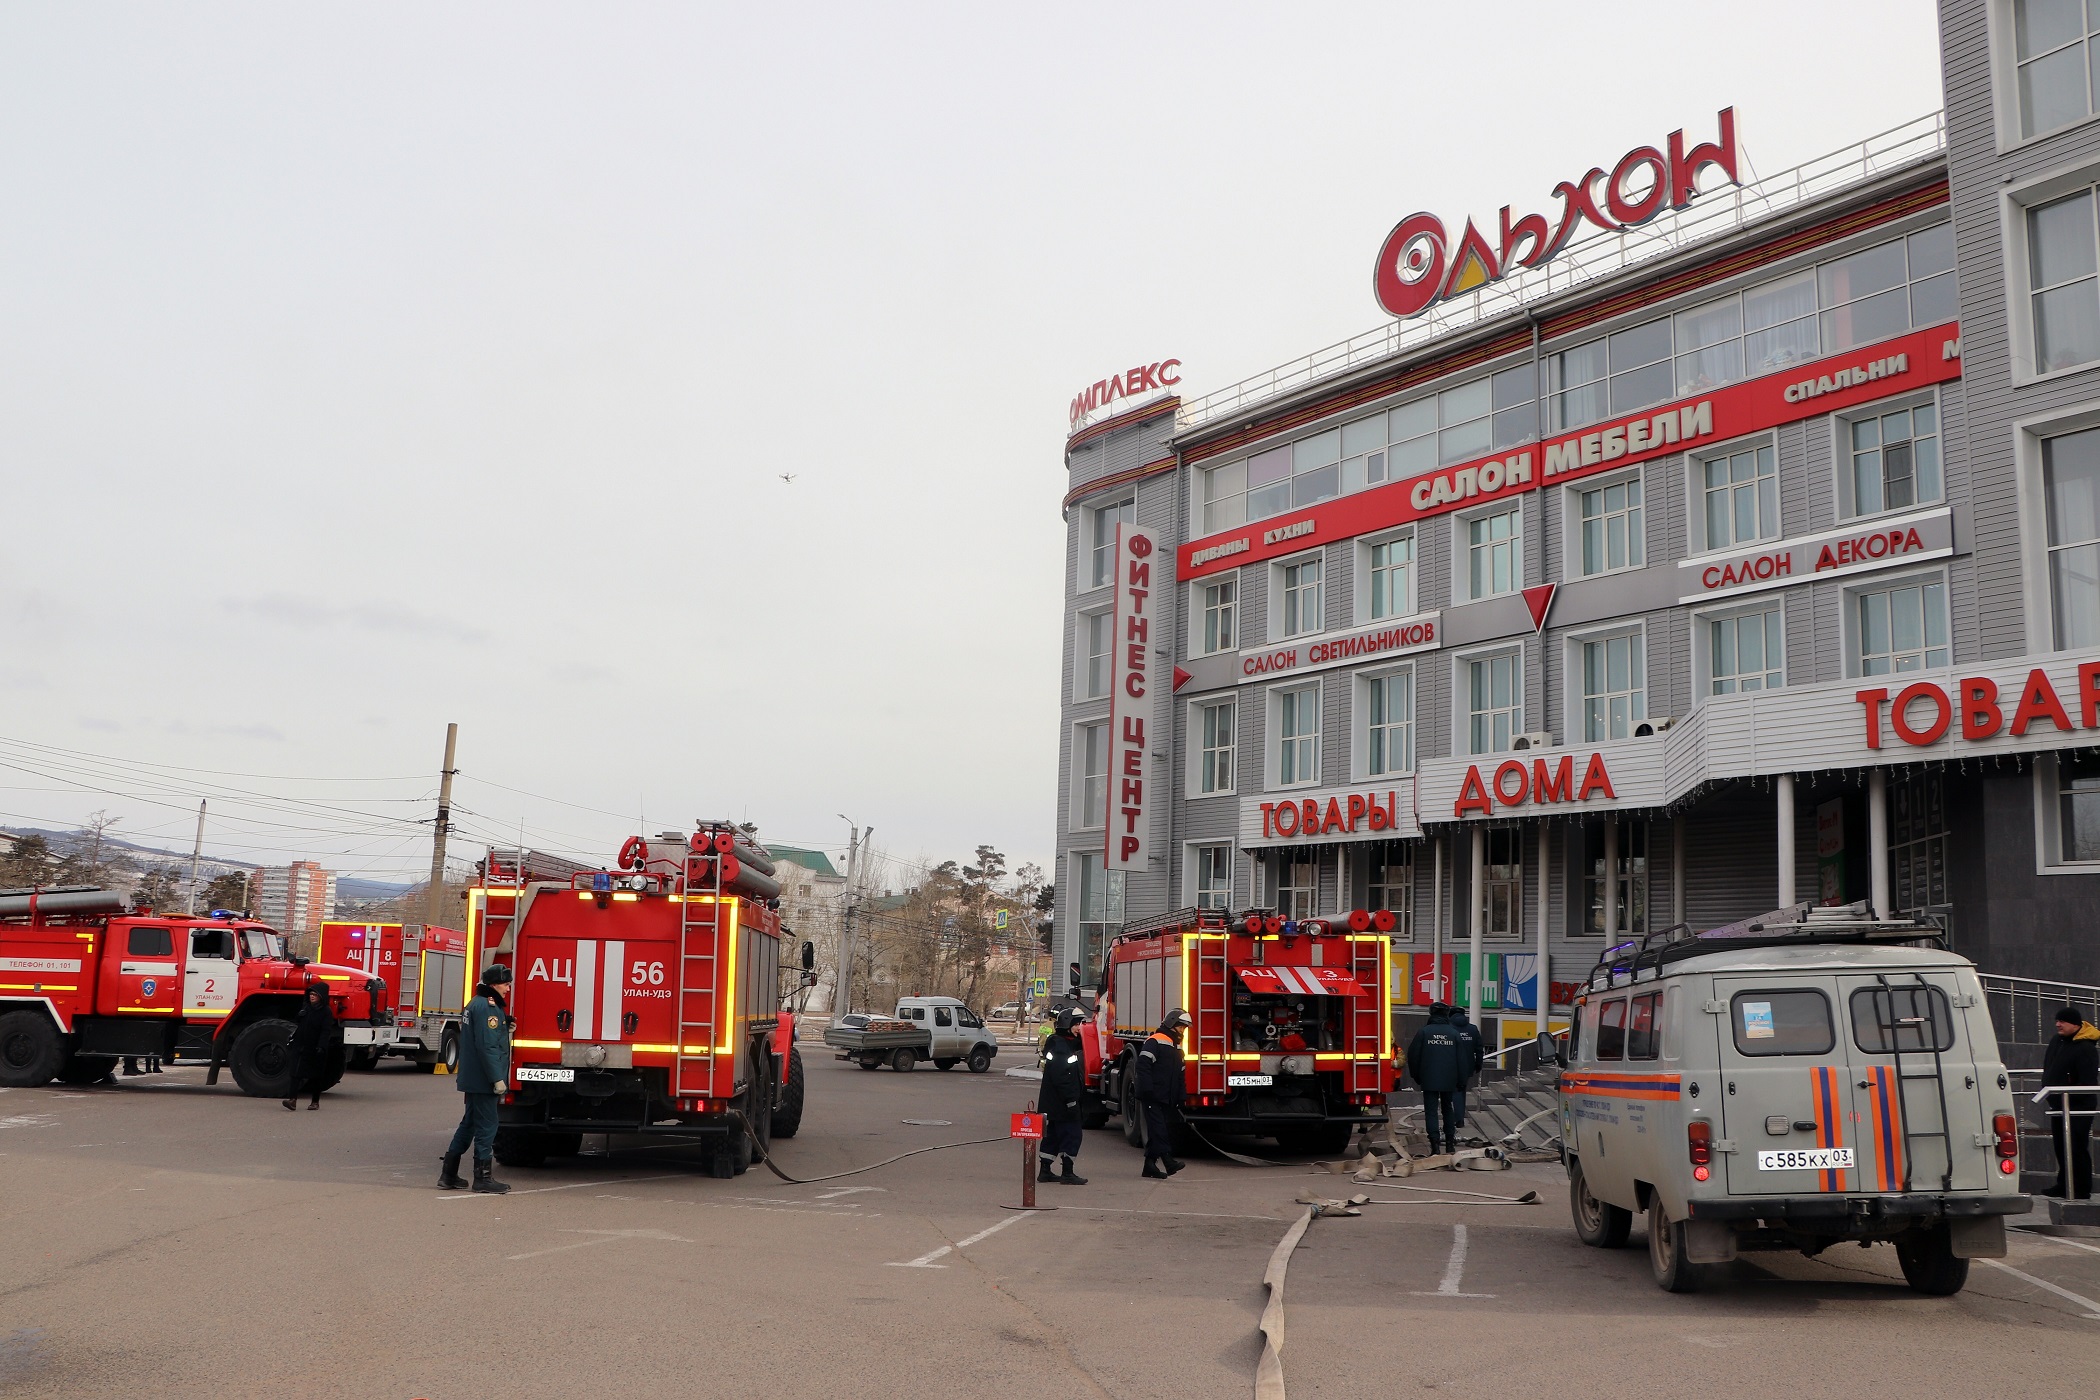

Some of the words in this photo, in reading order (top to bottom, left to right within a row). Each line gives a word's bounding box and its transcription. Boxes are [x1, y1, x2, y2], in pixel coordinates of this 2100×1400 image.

[1069, 358, 1182, 423] ОМПЛЕКС
[1784, 352, 1908, 404] СПАЛЬНИ
[1410, 451, 1533, 511] САЛОН
[1543, 400, 1713, 477] МЕБЕЛИ
[1190, 538, 1250, 568] ДИВАНЫ
[1263, 519, 1315, 545] КУХНИ
[1702, 552, 1791, 589] САЛОН
[1815, 527, 1924, 573] ДЕКОРА
[1125, 533, 1152, 698] ФИТНЕС
[1243, 650, 1297, 675] САЛОН
[1309, 622, 1435, 663] СВЕТИЛЬНИКОВ
[1121, 716, 1145, 861] ЦЕНТР
[1260, 791, 1397, 838] ТОВАРЫ
[1454, 752, 1618, 818] ДОМА
[9, 961, 44, 969] ТЕЛЕФОН
[346, 950, 362, 962] АЦ
[384, 950, 392, 961] 8
[205, 979, 215, 993] 2
[527, 957, 573, 987] АЦ
[631, 961, 665, 985] 56
[1240, 969, 1277, 978] АЦ
[1322, 970, 1338, 978] 3
[623, 988, 672, 999] УЛАН-УДЭ
[1833, 1150, 1848, 1162] 03
